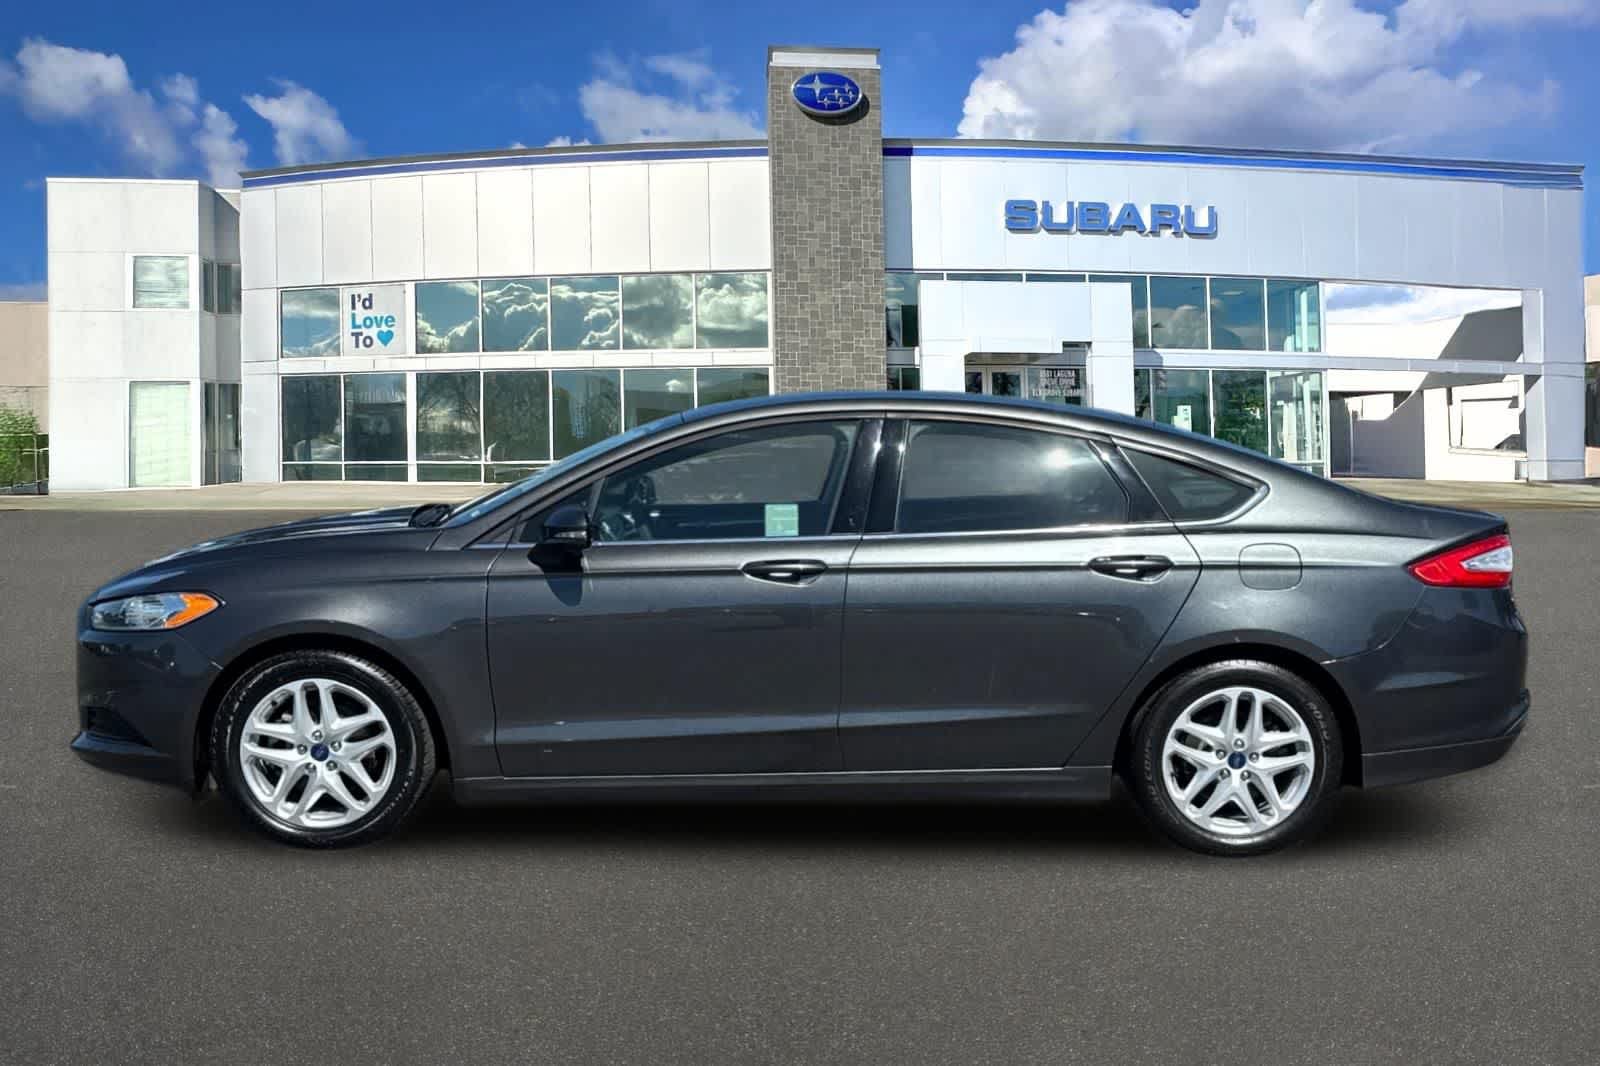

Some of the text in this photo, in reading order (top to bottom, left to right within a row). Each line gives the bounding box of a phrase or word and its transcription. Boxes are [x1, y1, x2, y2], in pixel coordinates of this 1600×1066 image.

[1005, 199, 1217, 238] SUBARU
[351, 312, 396, 329] Love
[351, 331, 374, 348] To
